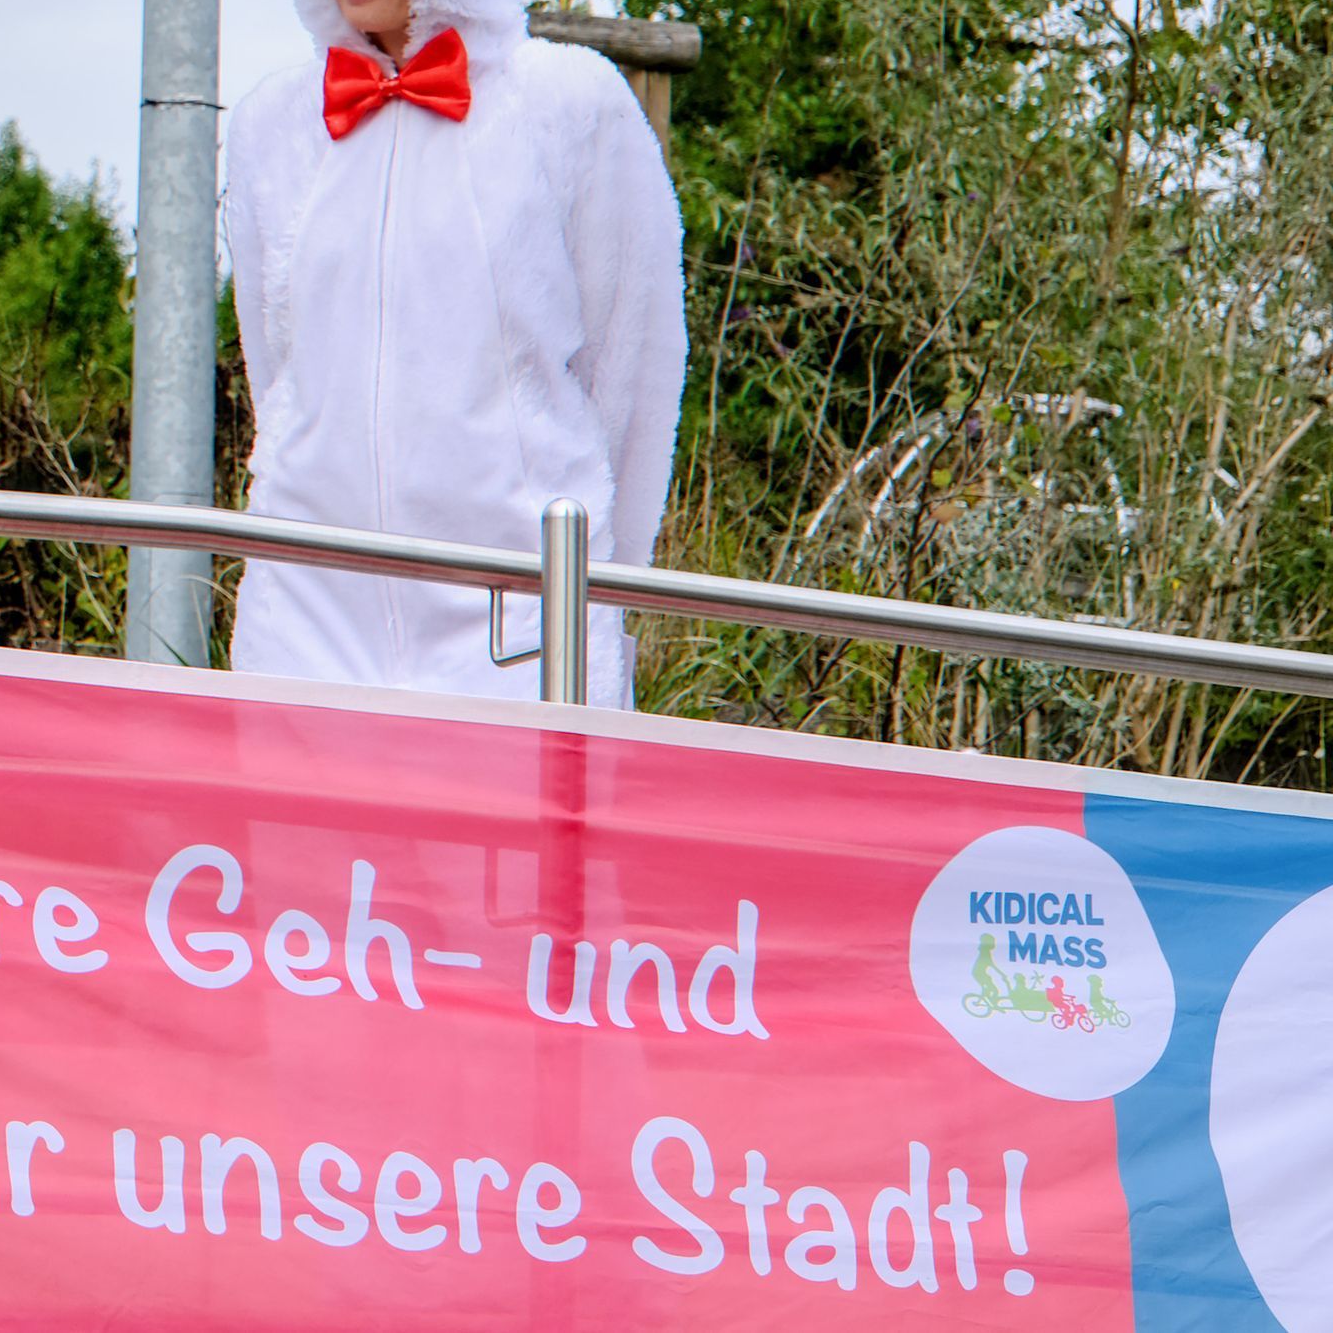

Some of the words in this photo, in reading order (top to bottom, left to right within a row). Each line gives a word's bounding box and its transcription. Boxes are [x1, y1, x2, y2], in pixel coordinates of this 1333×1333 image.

[143, 844, 482, 1010] Geh-
[526, 899, 771, 1041] und
[969, 891, 1105, 926] KIDICAL
[1007, 930, 1107, 969] MASS
[112, 1128, 587, 1263] unsere
[630, 1115, 1035, 1297] Stadt!
